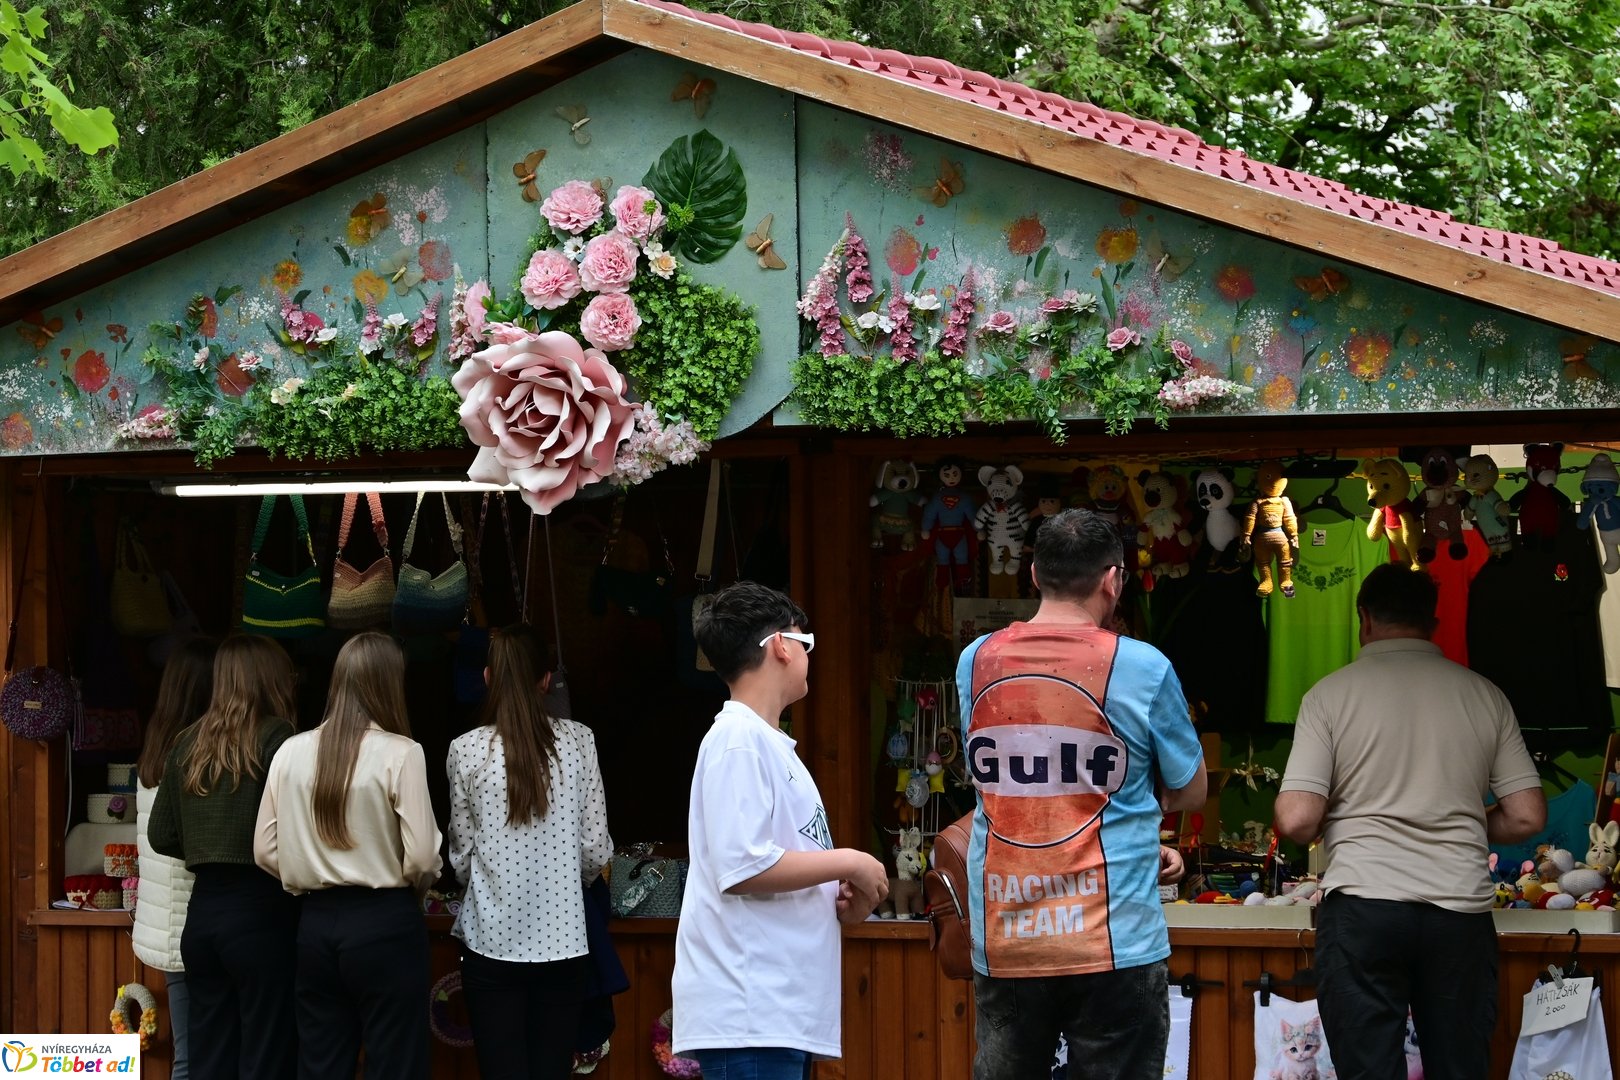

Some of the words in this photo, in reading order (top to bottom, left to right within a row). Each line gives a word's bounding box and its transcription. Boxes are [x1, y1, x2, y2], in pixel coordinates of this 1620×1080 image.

[969, 736, 1119, 786] Gulf
[987, 869, 1099, 905] RACING
[997, 905, 1084, 938] TEAM
